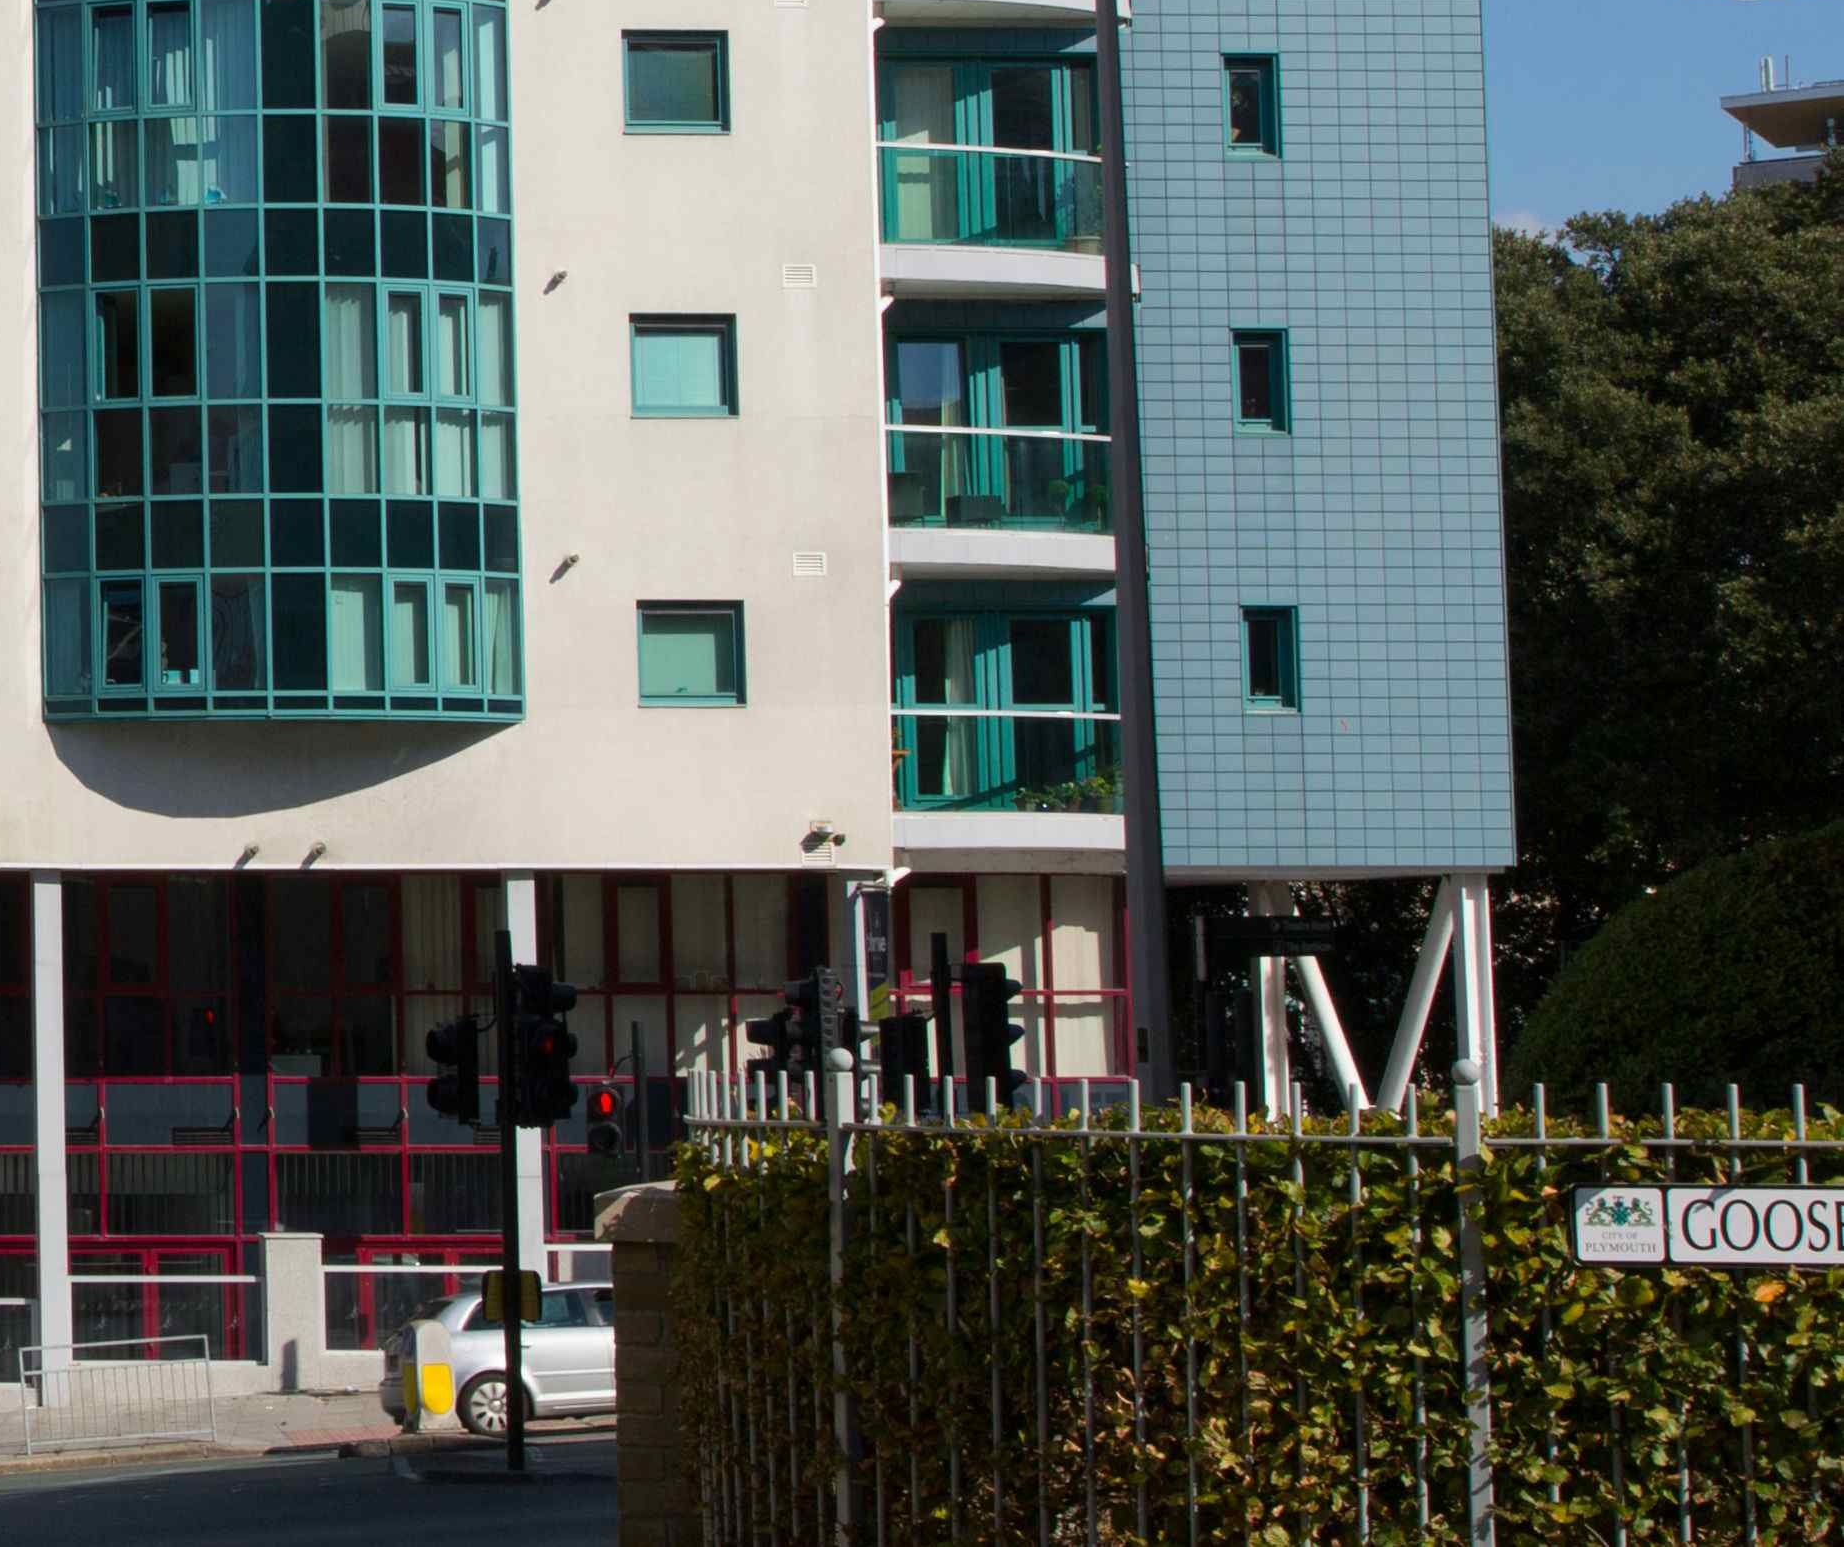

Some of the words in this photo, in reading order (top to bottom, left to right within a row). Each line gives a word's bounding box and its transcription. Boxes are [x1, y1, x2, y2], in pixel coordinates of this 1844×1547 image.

[1601, 1231, 1625, 1240] CITY
[1626, 1231, 1639, 1240] OF
[1584, 1242, 1657, 1254] PLYMOUTH
